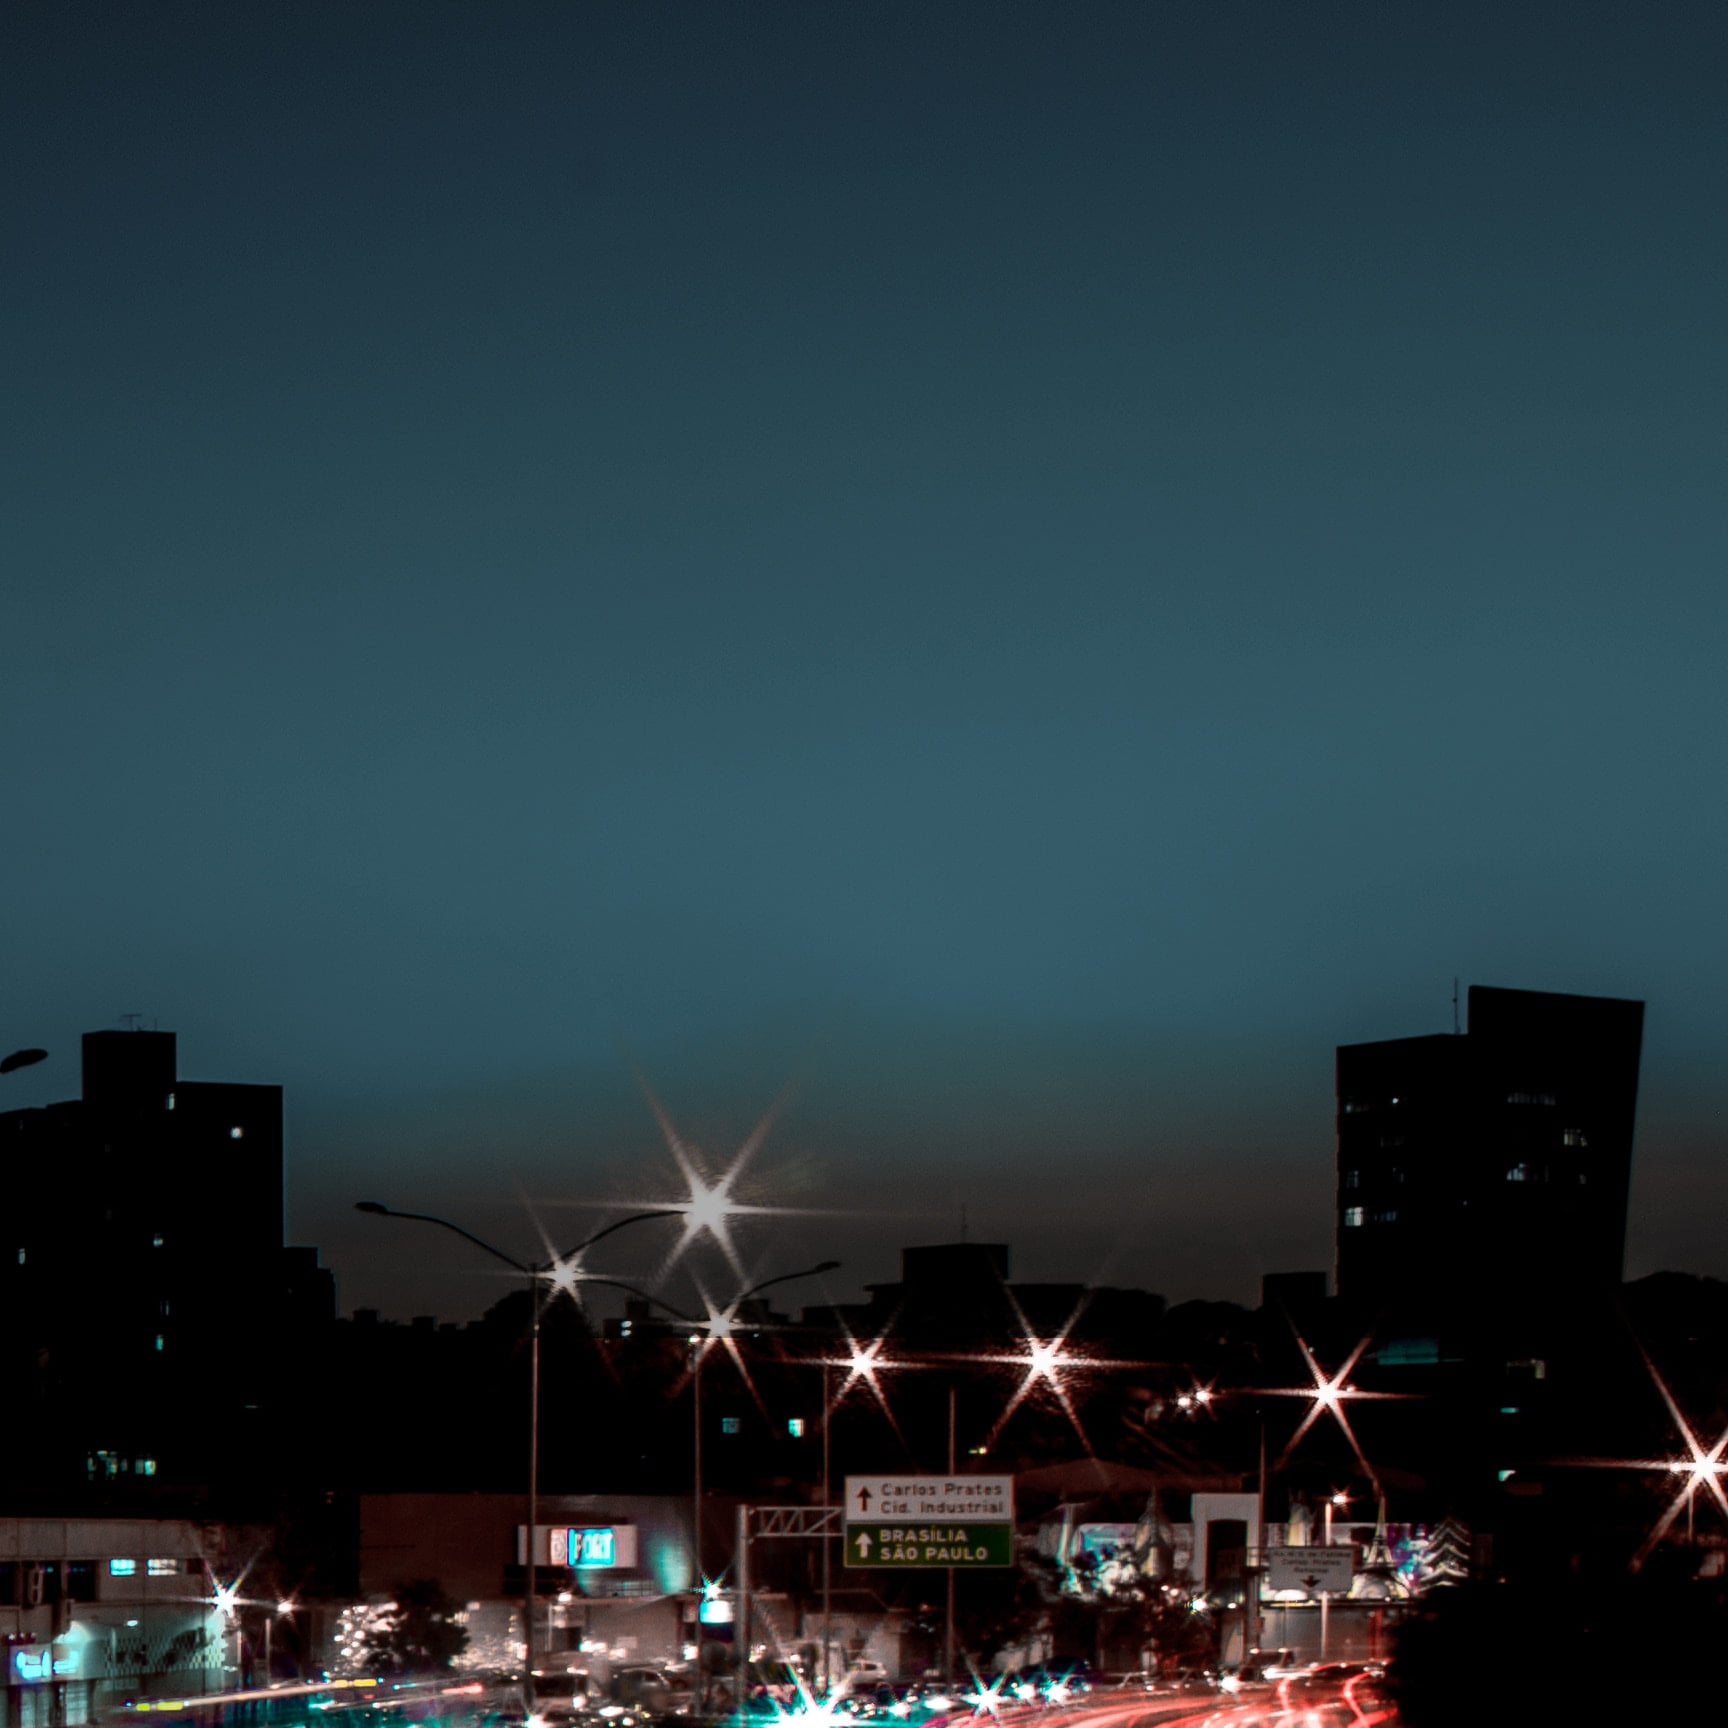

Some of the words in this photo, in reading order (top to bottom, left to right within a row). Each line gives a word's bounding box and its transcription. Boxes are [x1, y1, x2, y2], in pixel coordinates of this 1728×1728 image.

[881, 1483, 937, 1496] Carlos
[944, 1483, 1002, 1496] Prates
[881, 1501, 912, 1514] Cid.
[921, 1501, 1003, 1514] Industrial
[879, 1525, 968, 1542] BRASÍLIA
[880, 1544, 920, 1560] SÃO
[925, 1547, 989, 1560] PAULO
